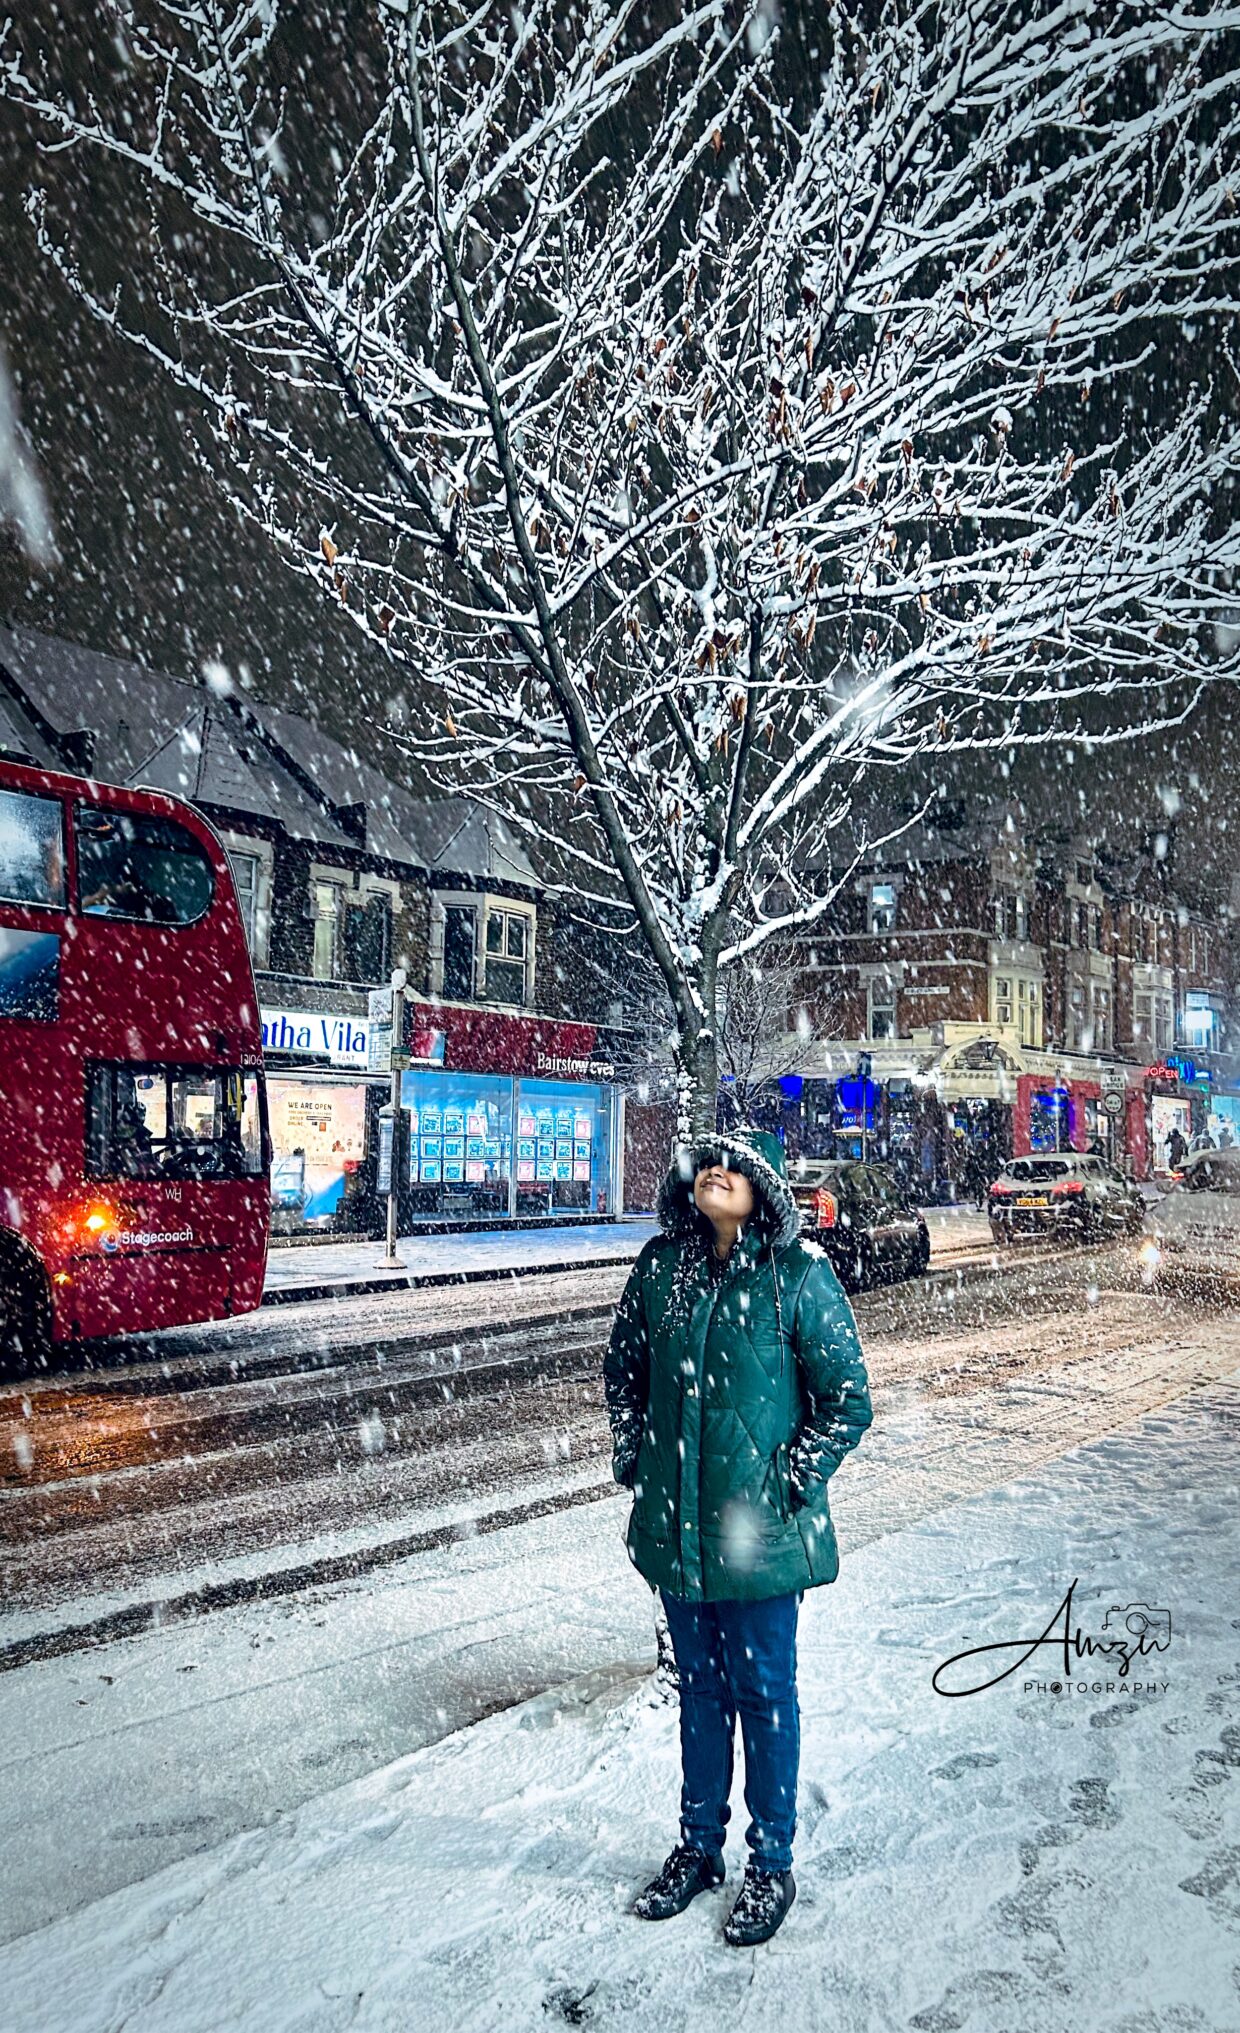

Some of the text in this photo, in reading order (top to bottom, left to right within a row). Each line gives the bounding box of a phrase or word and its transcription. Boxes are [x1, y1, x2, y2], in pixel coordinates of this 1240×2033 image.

[321, 1020, 366, 1052] Vila
[1149, 1067, 1178, 1079] OPEN
[288, 1101, 332, 1111] WE ARE OPEN
[165, 1188, 182, 1200] WH
[121, 1228, 193, 1246] Stagecoach
